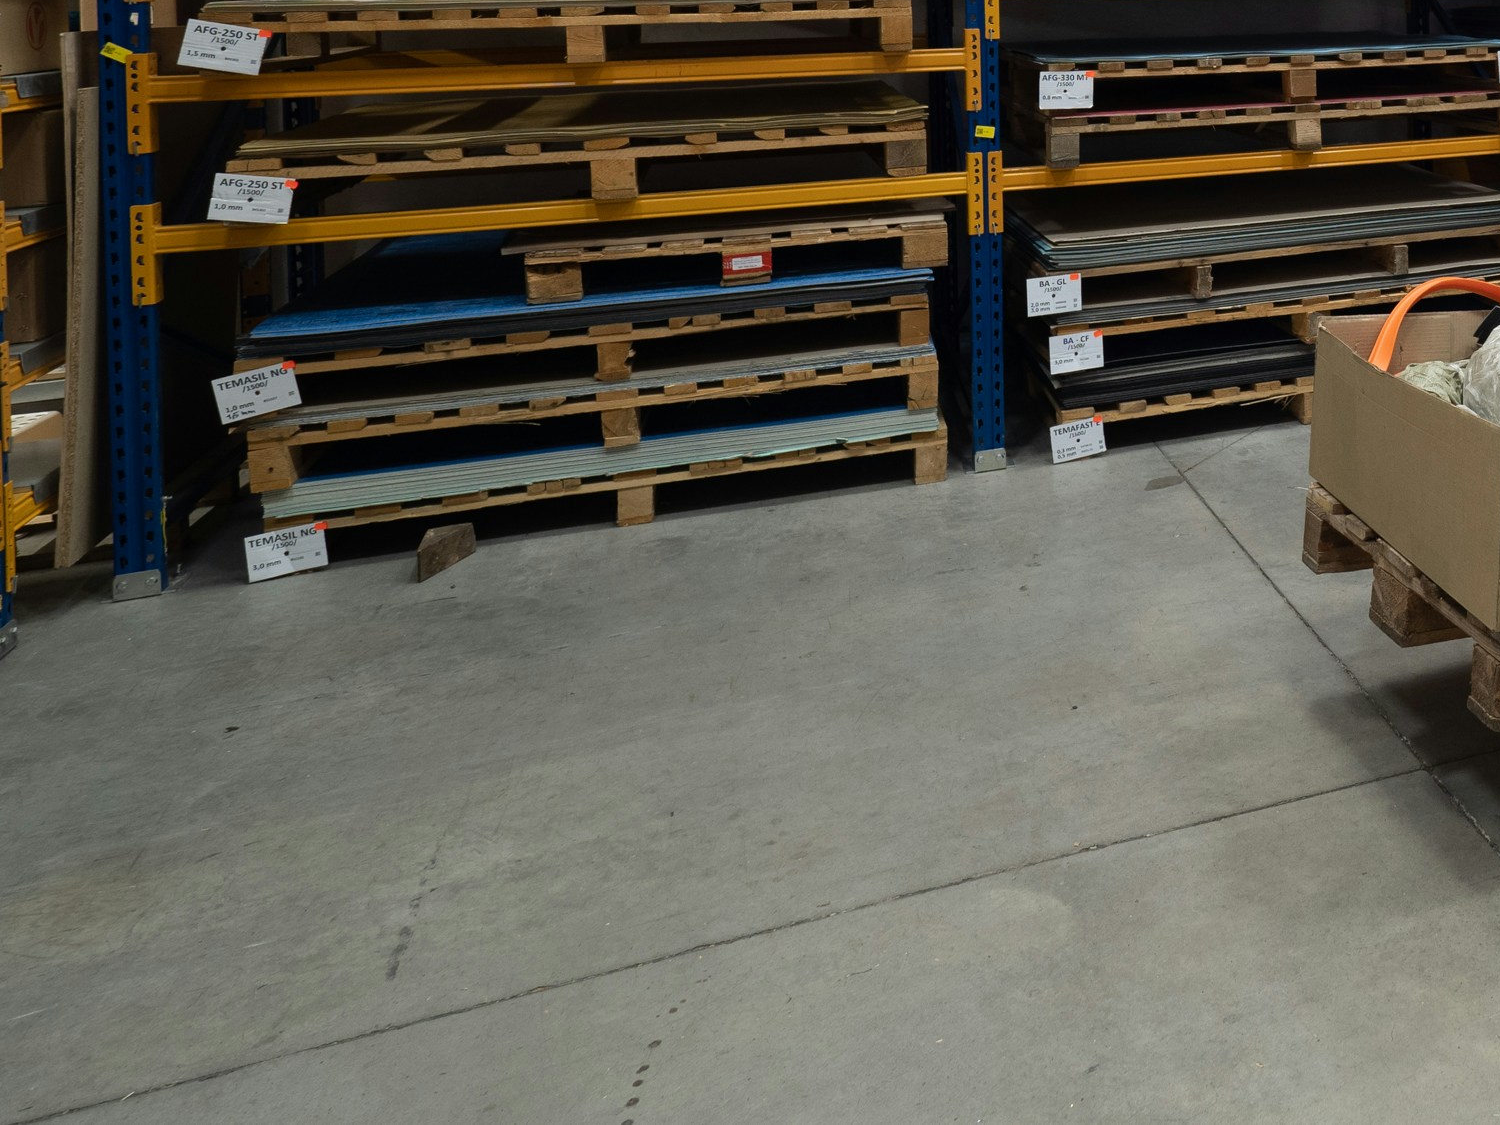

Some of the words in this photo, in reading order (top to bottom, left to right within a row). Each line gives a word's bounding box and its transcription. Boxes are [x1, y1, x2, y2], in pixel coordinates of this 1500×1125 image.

[193, 24, 243, 39] AFG-250
[245, 32, 259, 41] ST
[211, 36, 238, 46] /1500/
[186, 50, 199, 58] 1,5
[200, 52, 216, 60] mm
[1042, 74, 1075, 82] AFG-330
[219, 178, 269, 189] AFG-250
[271, 181, 285, 190] ST
[237, 188, 264, 196] /1500/
[214, 203, 226, 211] 1,0
[217, 374, 268, 392] TEMASIL
[270, 367, 288, 378] NG
[242, 381, 268, 393] /1500/
[226, 404, 238, 413] 1,0
[239, 402, 255, 410] mm
[1053, 421, 1094, 437] TEMAFAST
[1069, 430, 1086, 439] /1500/
[248, 532, 298, 548] TEMASIL
[300, 528, 317, 537] NG
[271, 539, 297, 551] /1500/
[252, 562, 265, 571] 3,0
